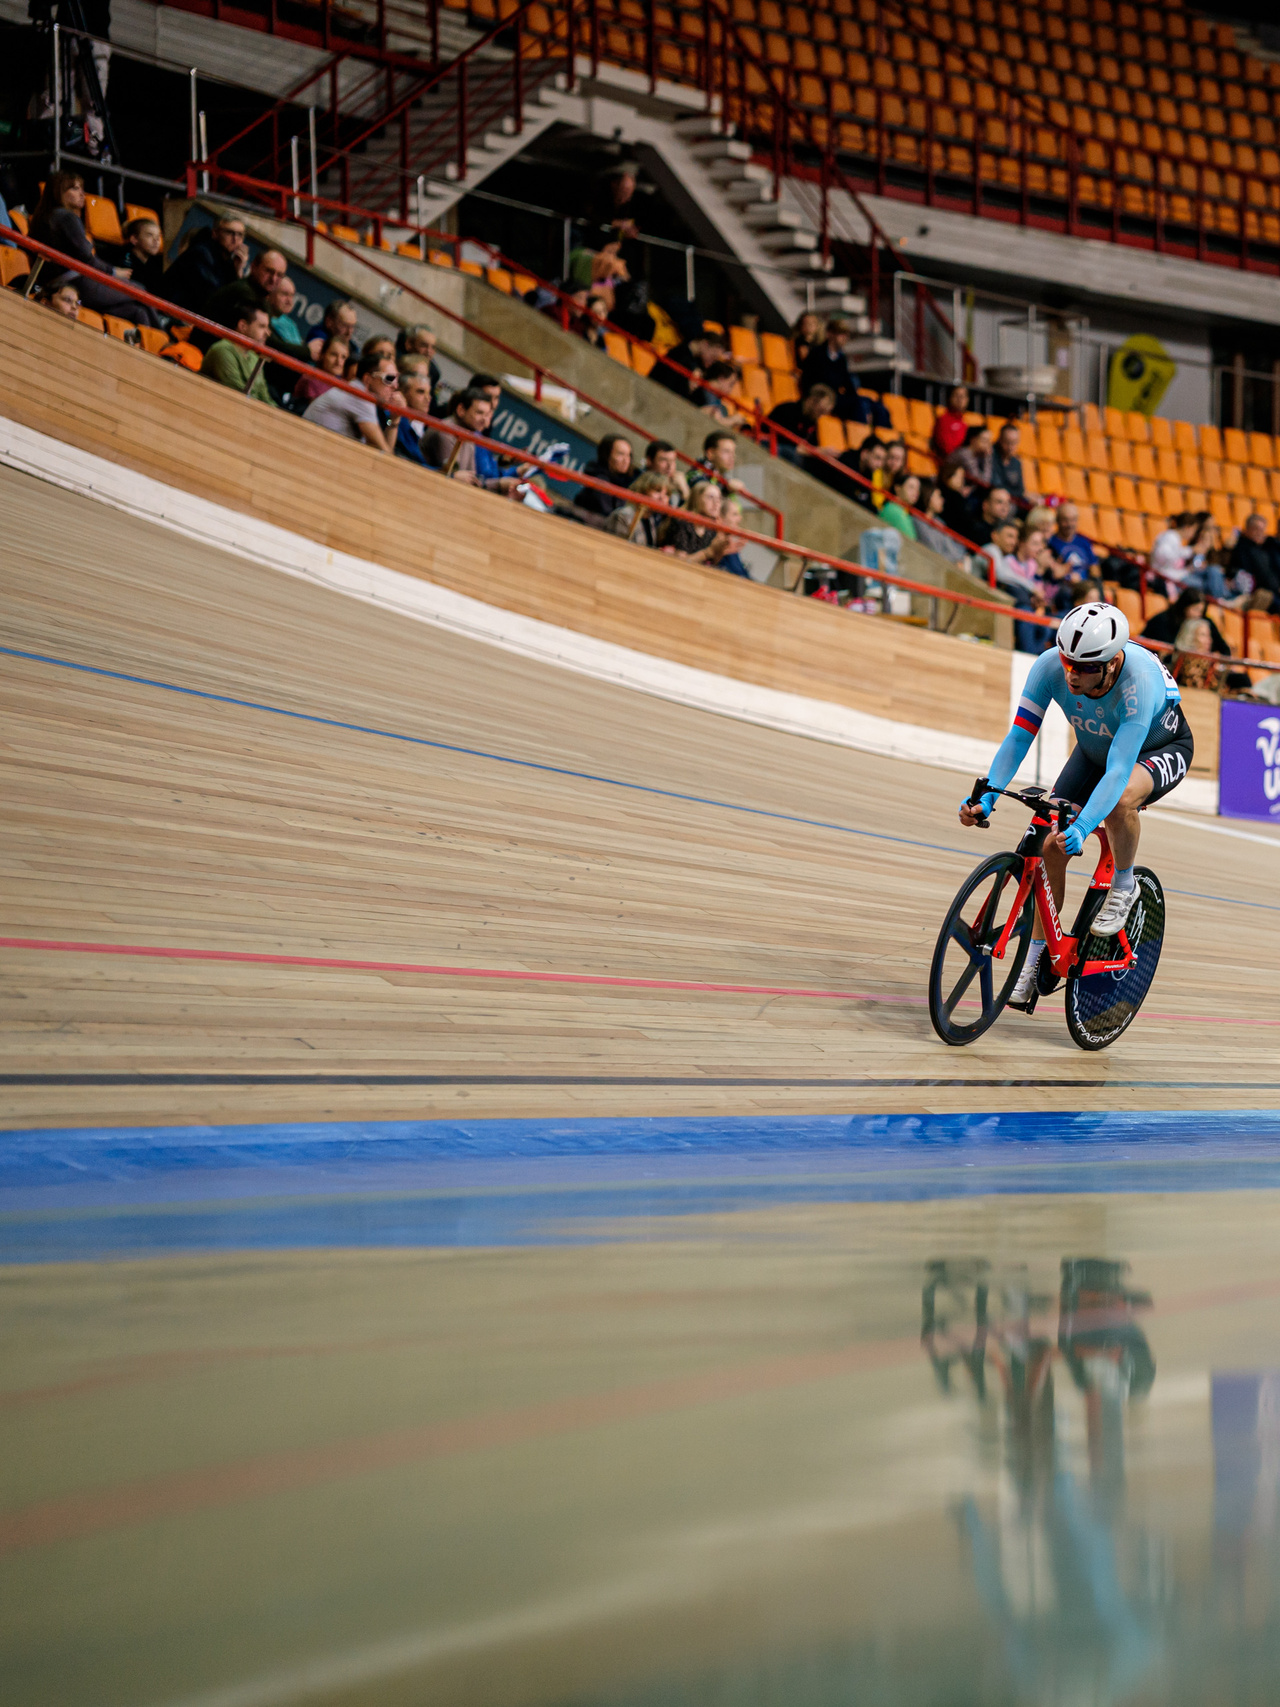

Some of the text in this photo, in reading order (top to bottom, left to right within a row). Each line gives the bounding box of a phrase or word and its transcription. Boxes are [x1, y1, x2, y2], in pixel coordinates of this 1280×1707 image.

[1122, 684, 1138, 717] RCA
[1070, 715, 1114, 739] RCA
[1159, 706, 1179, 734] RCA
[1150, 752, 1188, 788] RCA
[1039, 857, 1063, 942] PINARELLO
[1072, 978, 1133, 1044] CAMPAGNOLO
